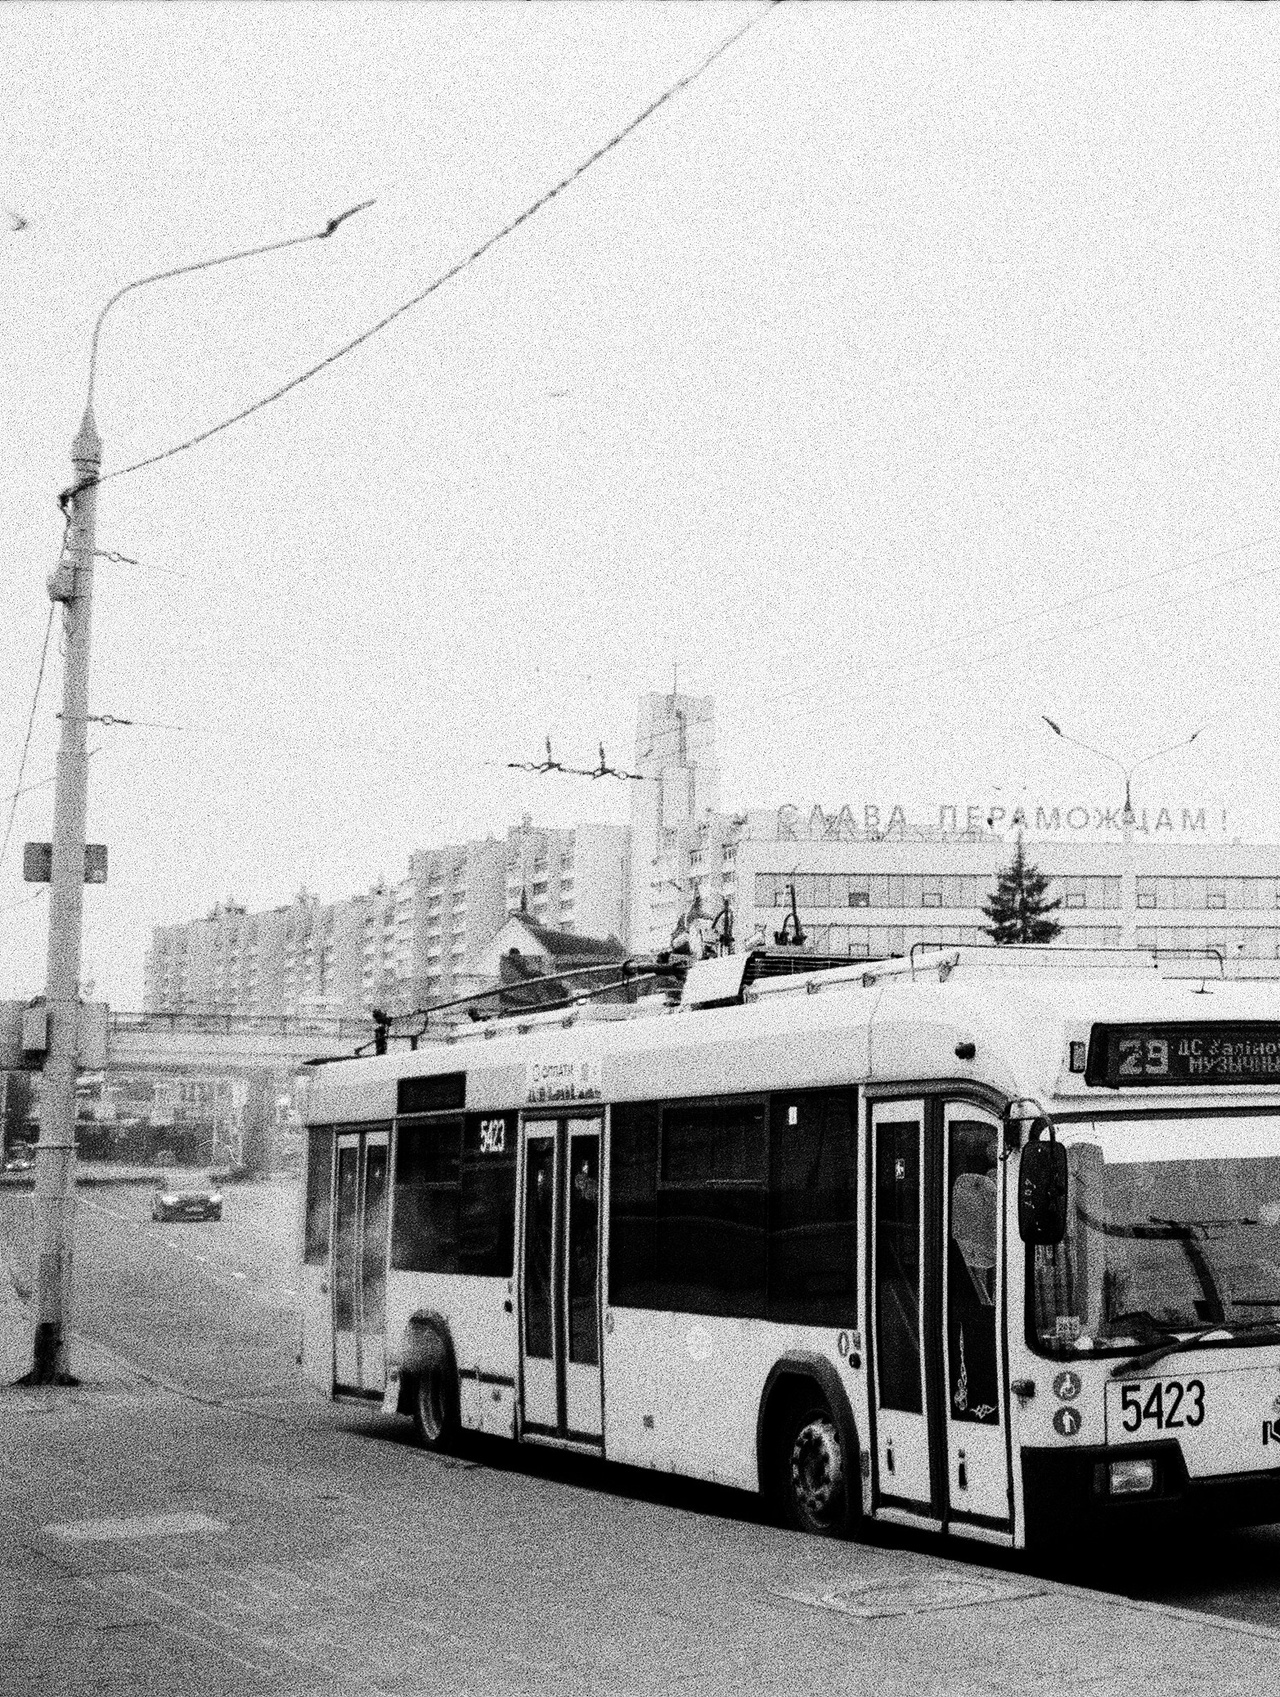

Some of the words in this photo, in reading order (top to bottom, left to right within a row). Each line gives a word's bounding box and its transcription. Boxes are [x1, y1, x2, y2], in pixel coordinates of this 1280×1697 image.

[777, 803, 907, 830] СЛАВА
[1118, 1039, 1169, 1075] 29
[1189, 1055, 1280, 1074] МУЗЫЧНЫ
[480, 1118, 506, 1153] 5423
[1121, 1379, 1206, 1432] 5423
